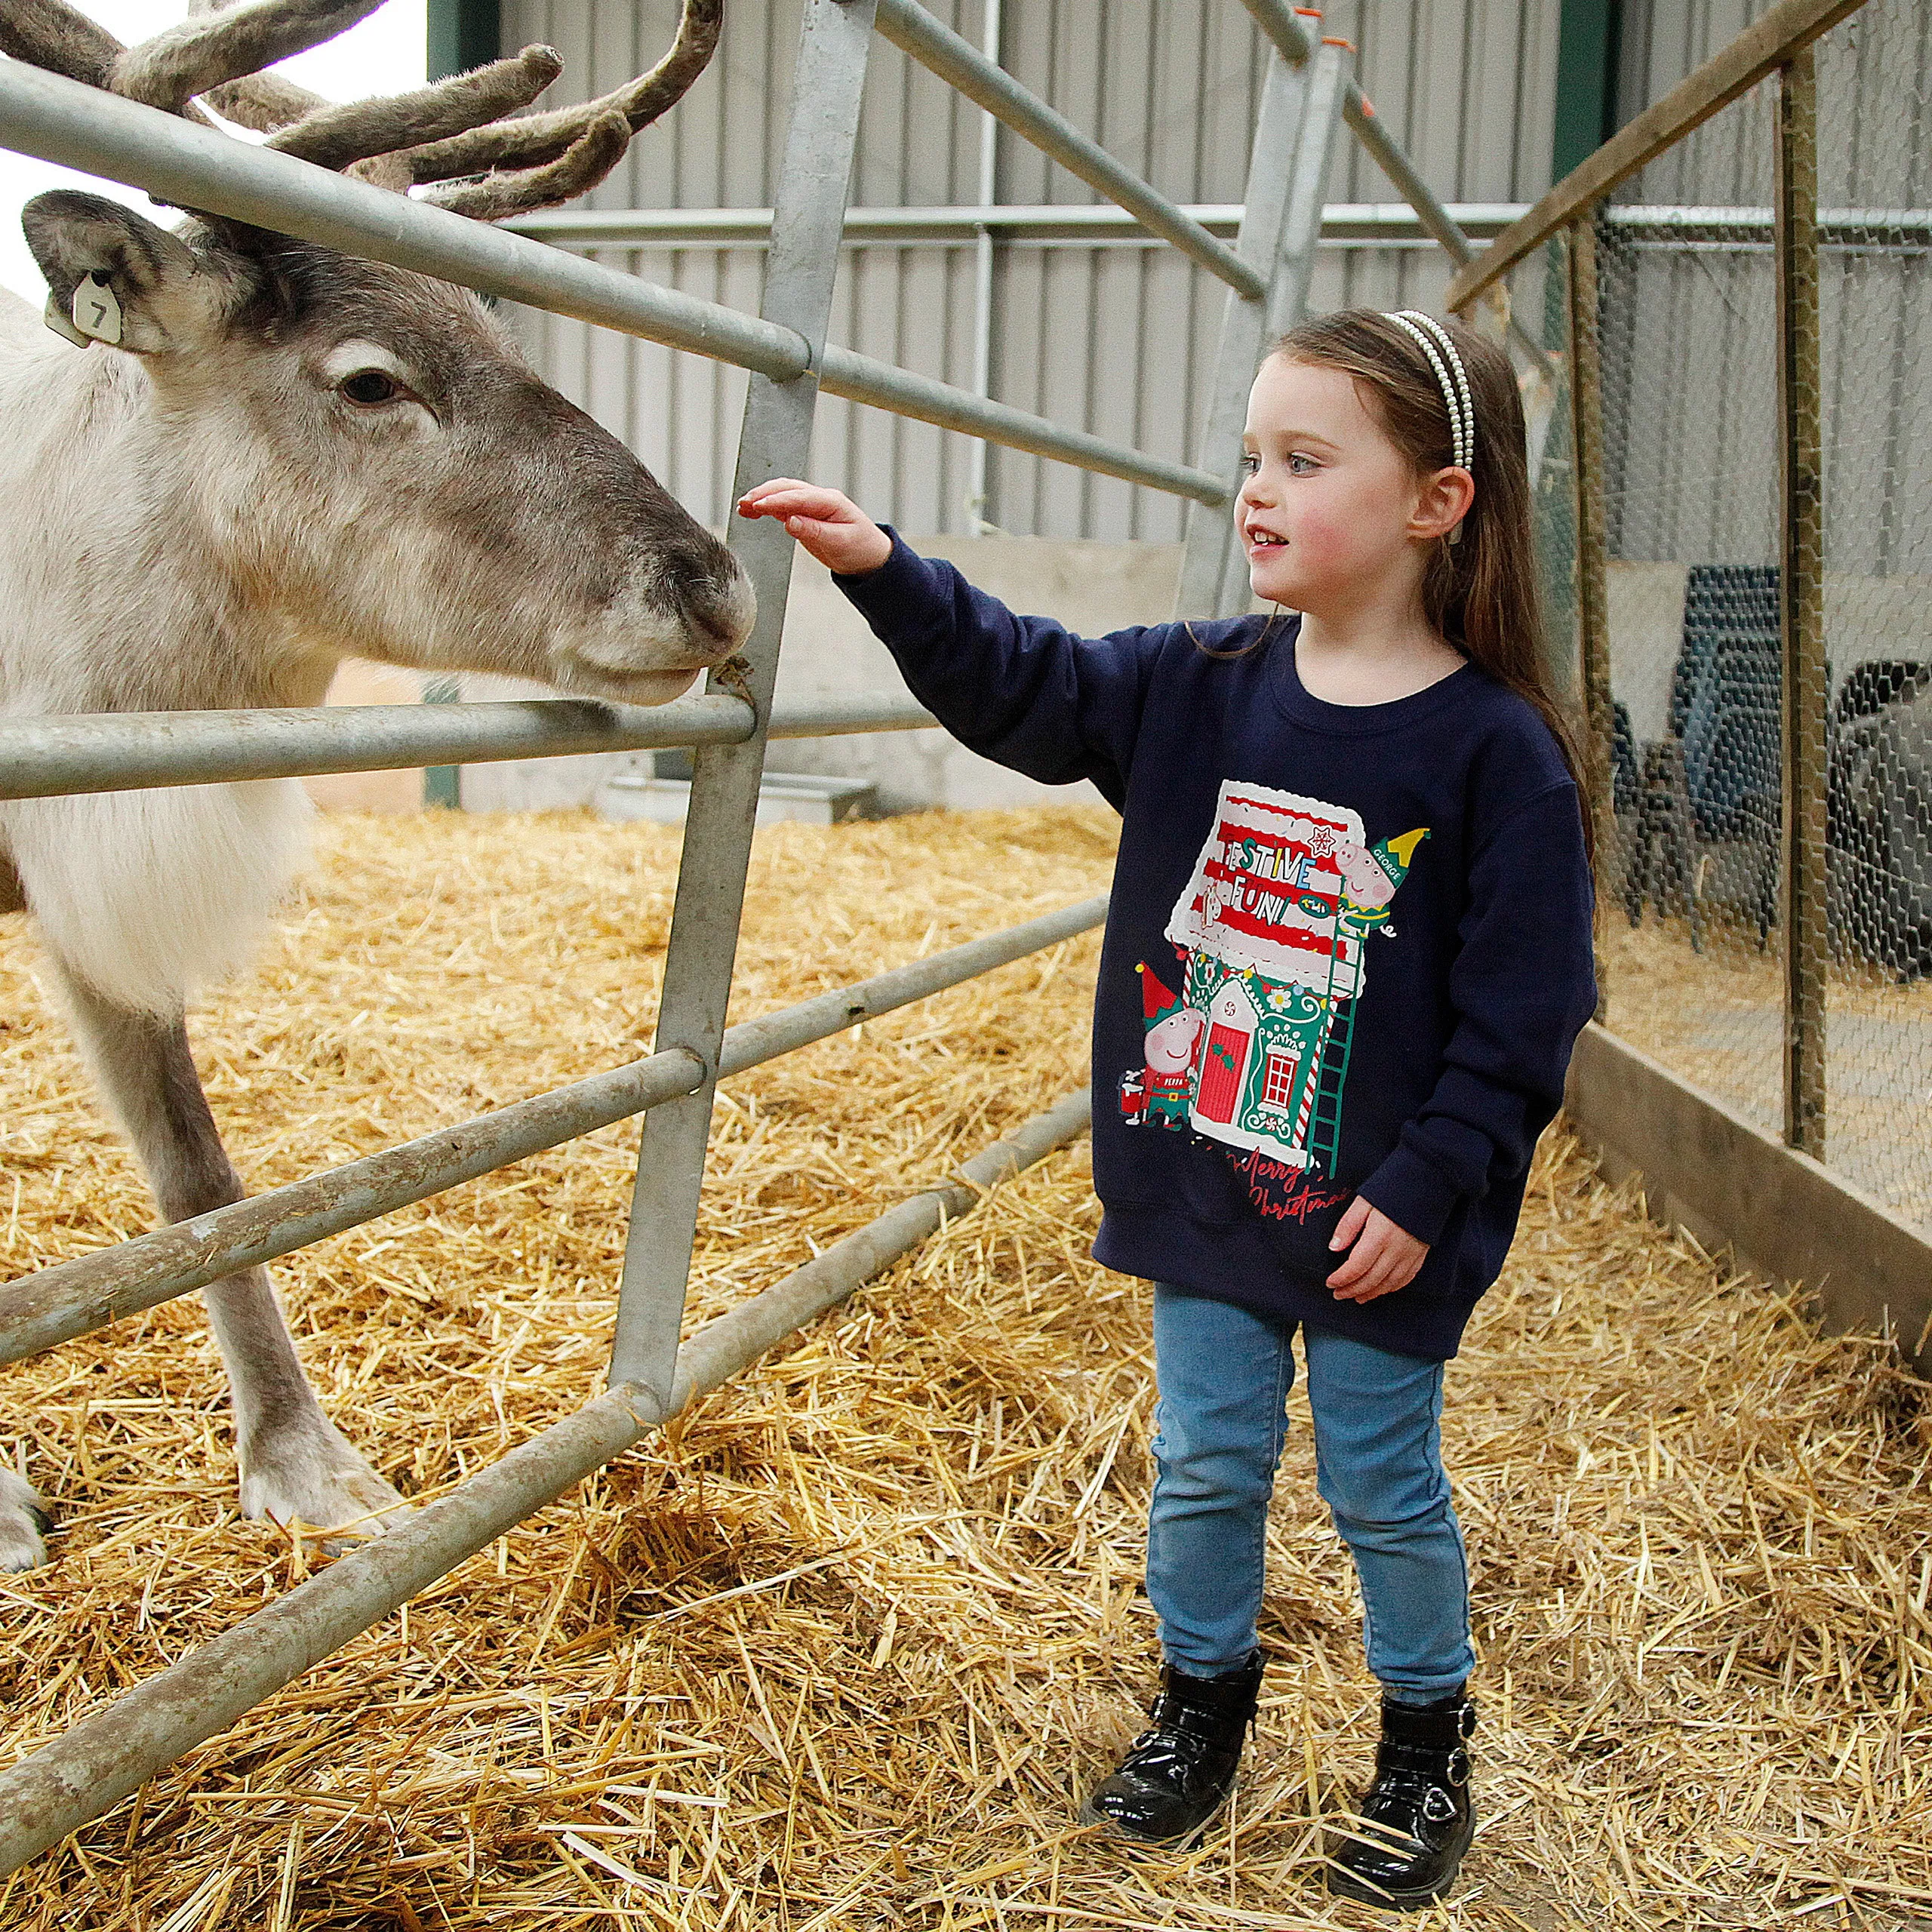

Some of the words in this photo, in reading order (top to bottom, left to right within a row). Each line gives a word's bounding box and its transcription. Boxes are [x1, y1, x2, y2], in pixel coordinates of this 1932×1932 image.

[90, 300, 107, 329] 7
[1374, 848, 1401, 880] GEORGE
[1230, 875, 1291, 926] FUN!
[1226, 1146, 1306, 1193] Merry
